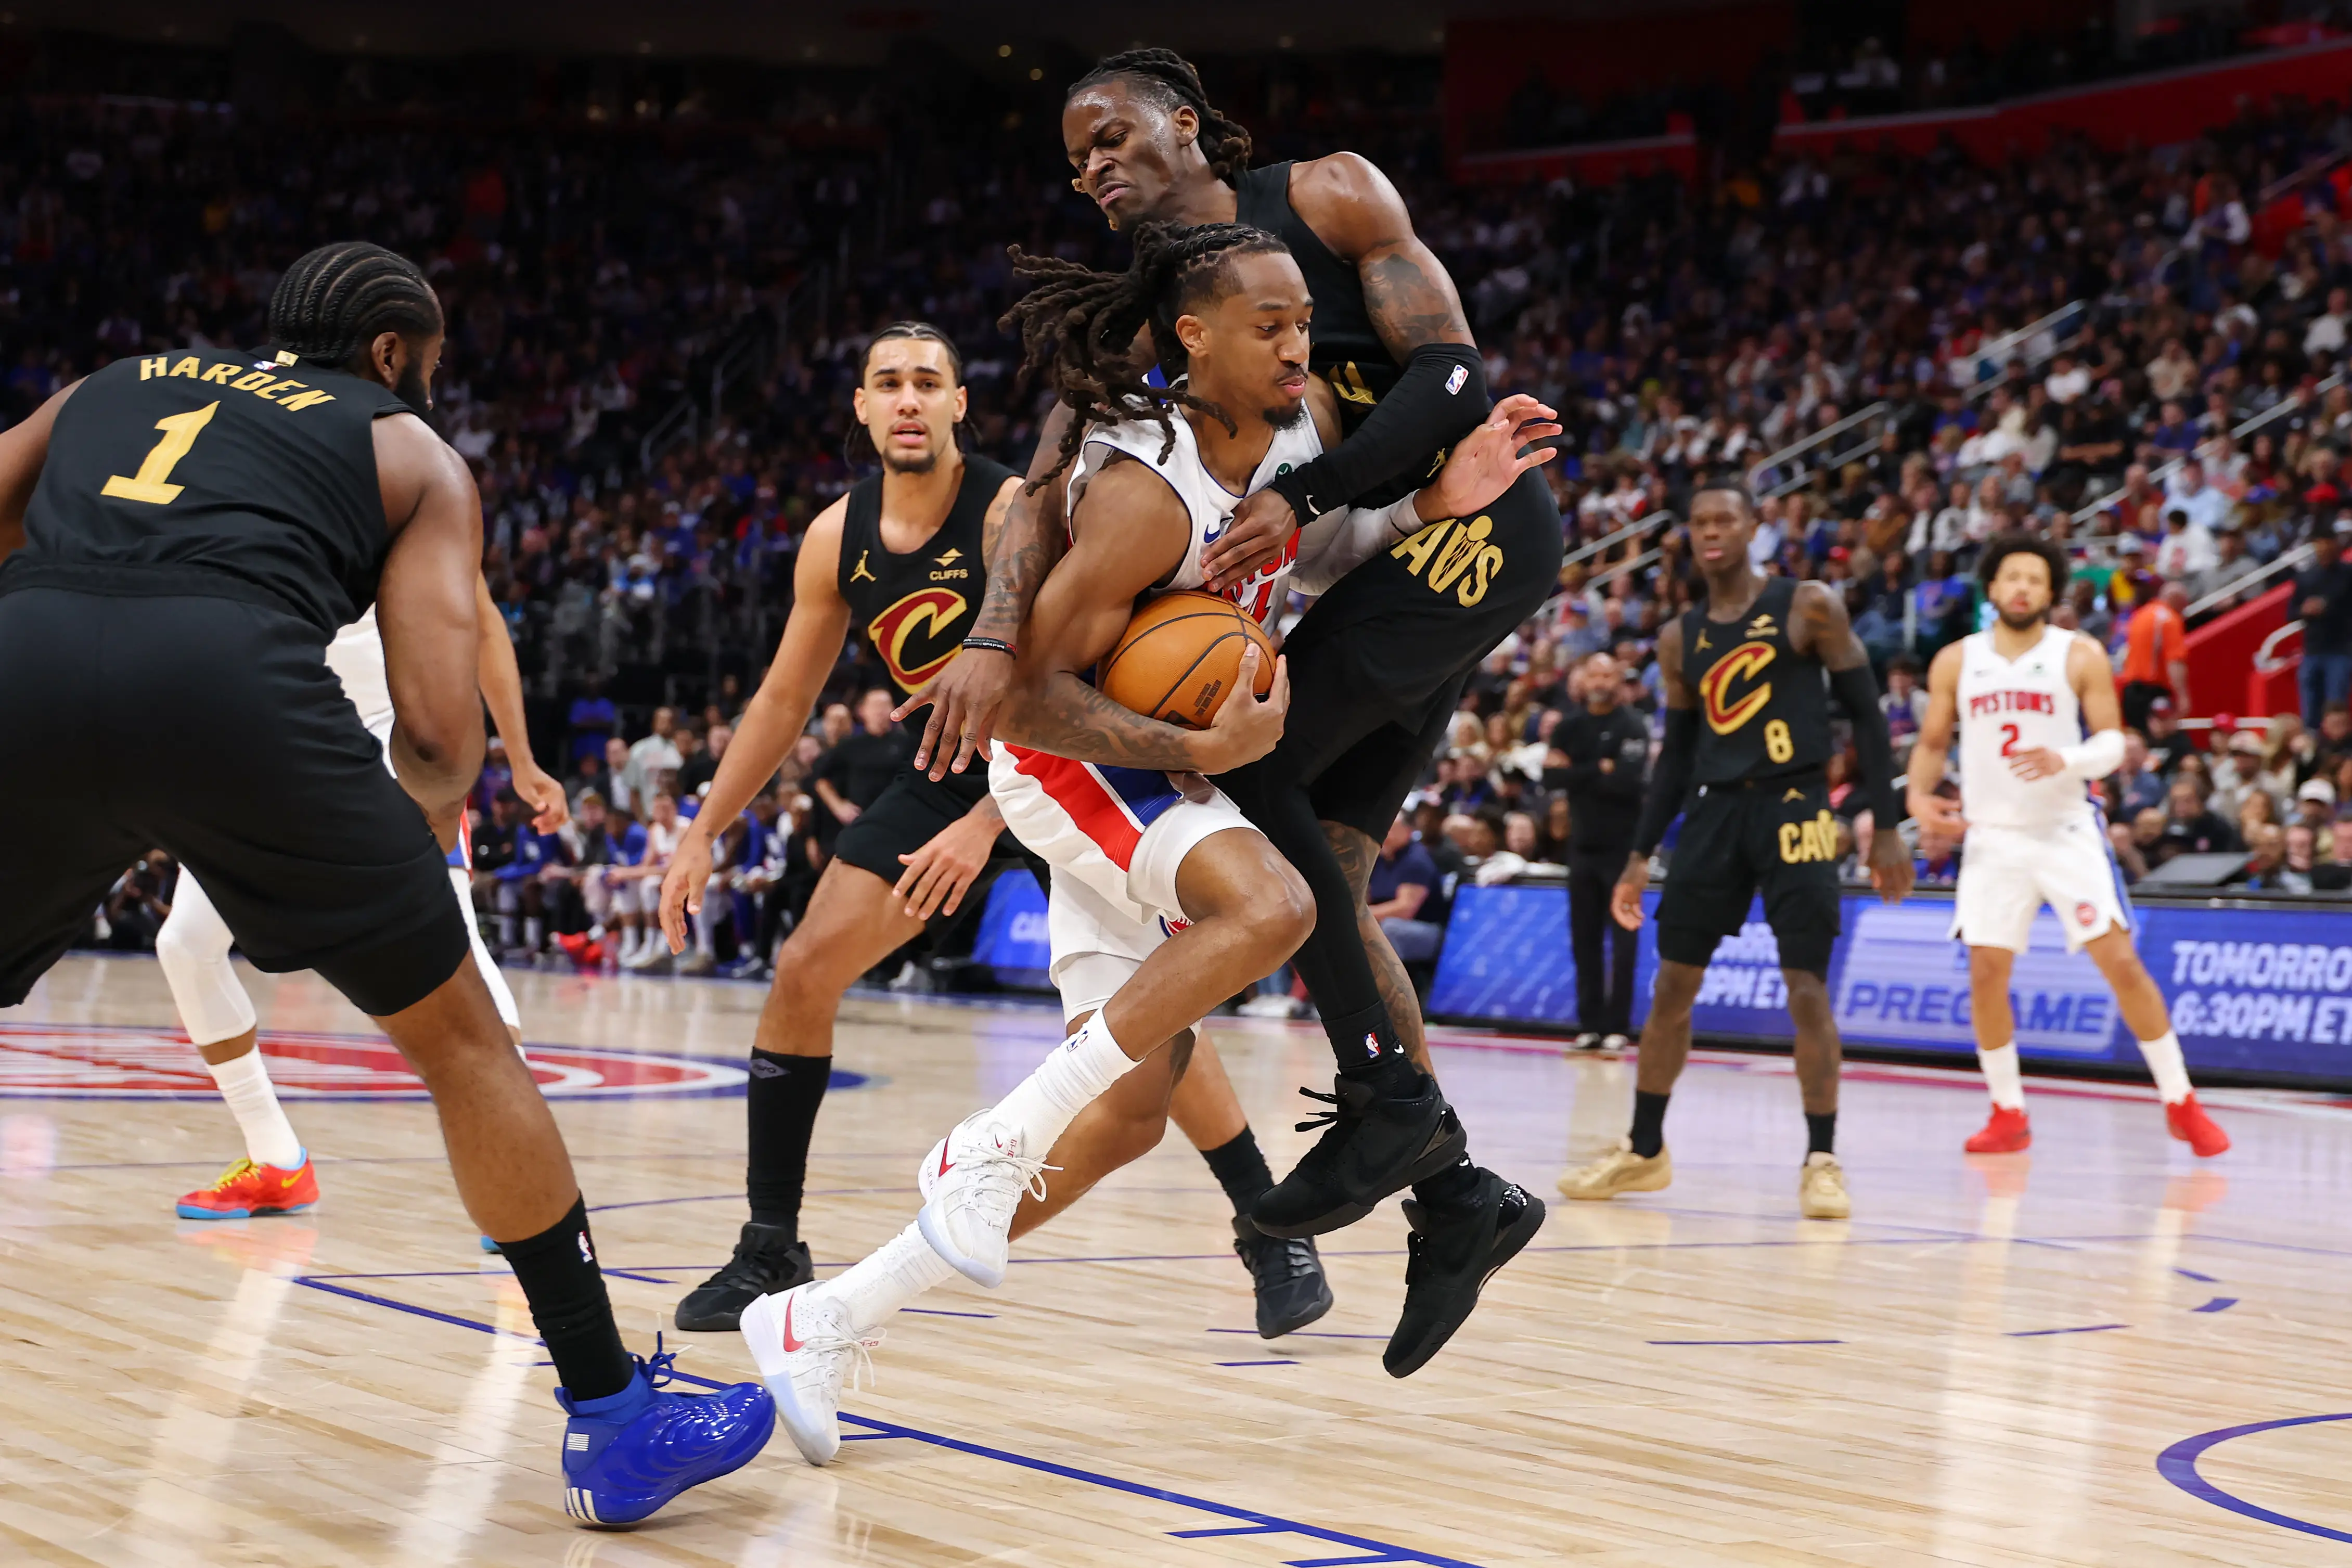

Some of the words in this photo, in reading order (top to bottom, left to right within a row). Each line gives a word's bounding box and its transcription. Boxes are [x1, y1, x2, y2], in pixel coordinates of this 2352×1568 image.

[140, 356, 337, 412] HARDEN
[100, 401, 221, 505] 1
[929, 569, 969, 581] CLIFFS
[1389, 515, 1504, 608] AVS
[1971, 691, 2054, 718] PISTONS
[1764, 718, 1794, 764] 8
[2001, 723, 2020, 757] 2
[2171, 990, 2313, 1043] 6:30PM
